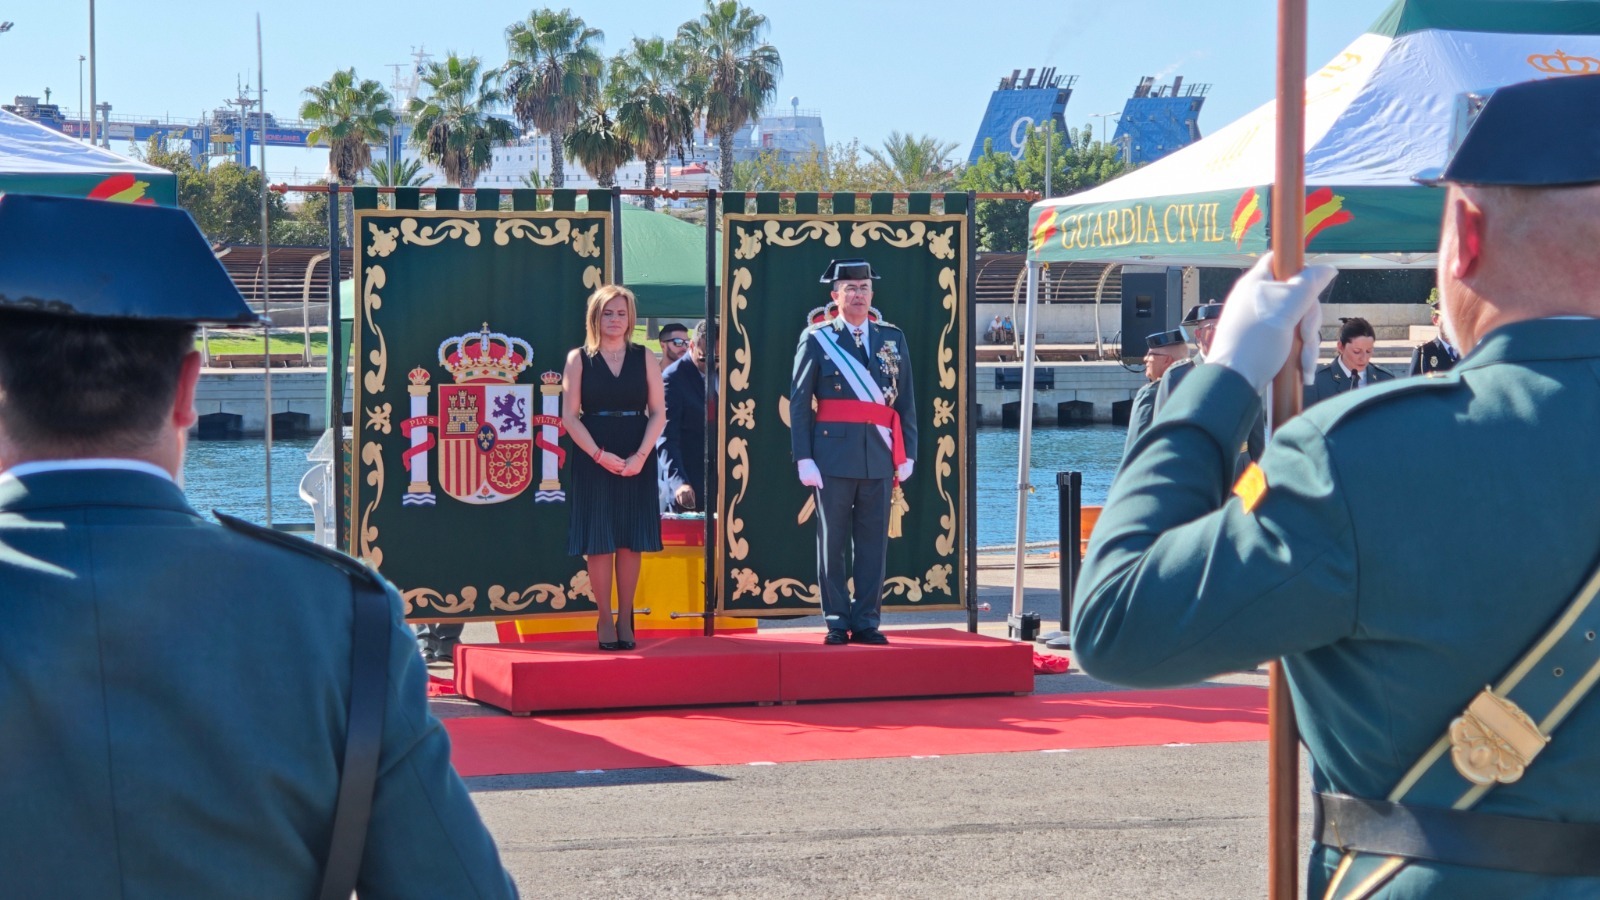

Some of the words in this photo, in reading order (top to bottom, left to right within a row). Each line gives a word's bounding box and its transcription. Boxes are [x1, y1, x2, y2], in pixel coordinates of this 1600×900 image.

[1061, 205, 1161, 249] GUARDIA
[1164, 203, 1225, 243] CIVIL
[409, 417, 434, 427] PLVS
